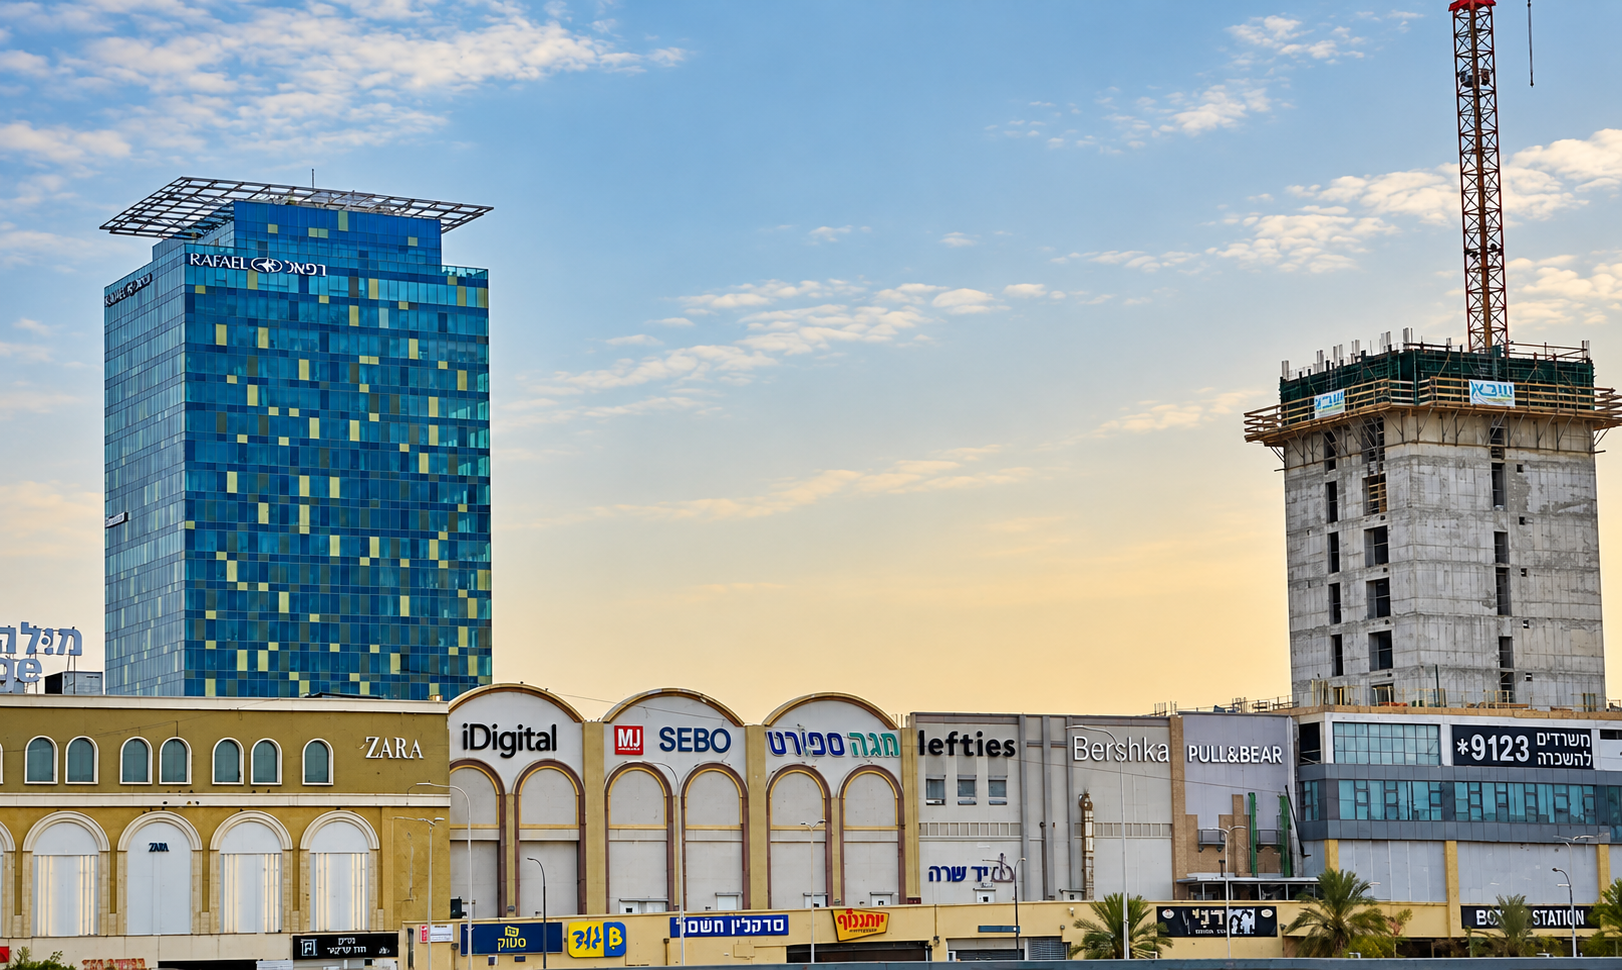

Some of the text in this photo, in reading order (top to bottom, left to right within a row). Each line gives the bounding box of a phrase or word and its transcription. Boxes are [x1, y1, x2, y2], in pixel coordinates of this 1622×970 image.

[190, 252, 248, 270] RAFAEL
[284, 259, 327, 277] רפאל
[365, 736, 424, 760] ZARA
[462, 722, 557, 759] iDigital
[617, 728, 641, 748] MJ
[659, 726, 732, 753] SEBO
[766, 730, 846, 757] ספורט
[918, 729, 1016, 757] lefties
[1536, 731, 1591, 748] משרדים
[1072, 735, 1170, 762] Bershka
[1188, 744, 1283, 764] PULL&BEAR
[1536, 750, 1592, 766] להשכרה
[928, 865, 967, 882] שרה
[1532, 909, 1585, 926] STATION
[497, 937, 527, 952] סטוק
